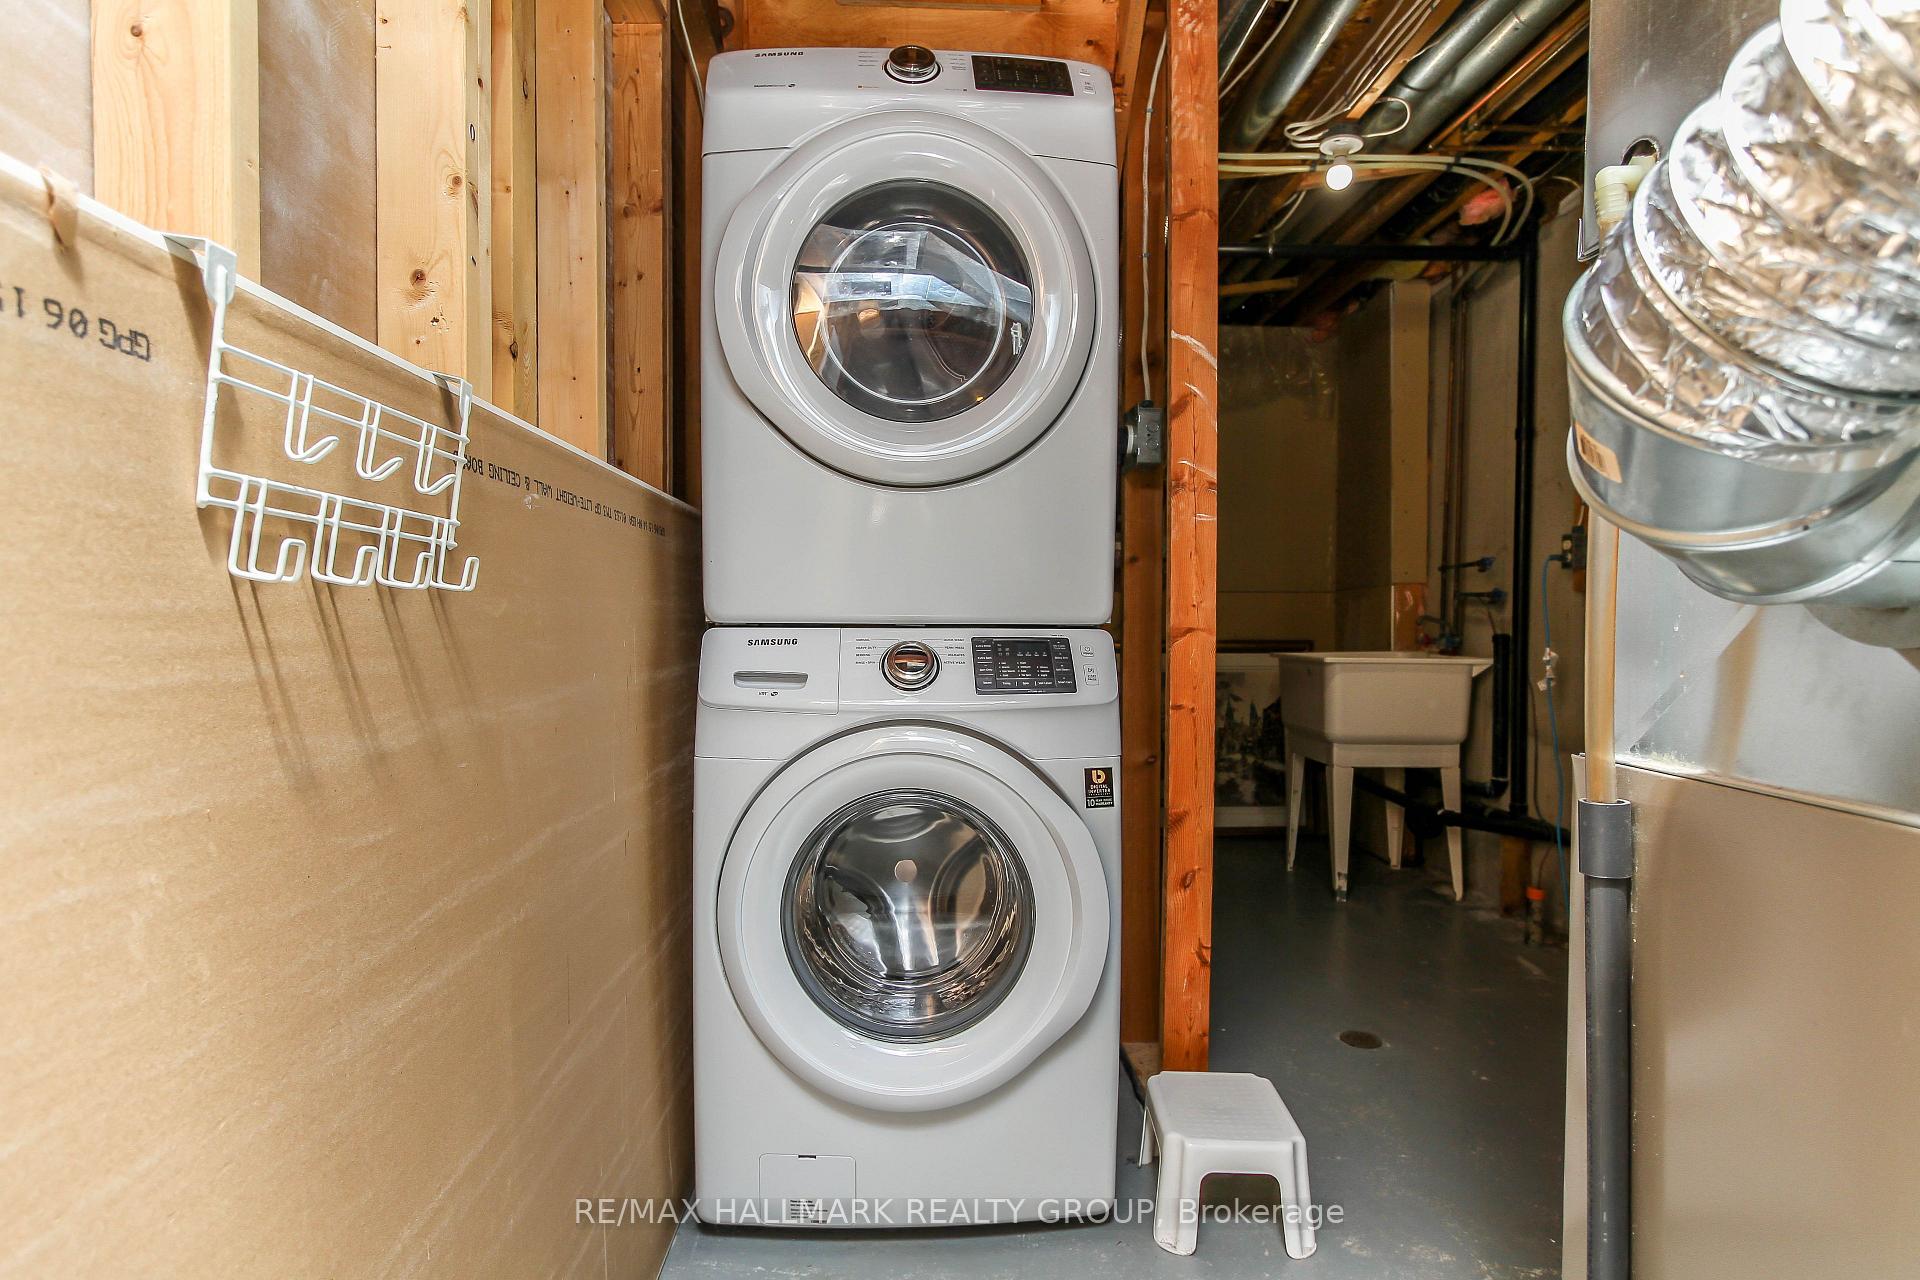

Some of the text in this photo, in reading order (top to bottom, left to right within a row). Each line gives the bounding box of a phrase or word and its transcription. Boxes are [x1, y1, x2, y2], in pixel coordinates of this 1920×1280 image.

[43, 298, 88, 338] 06
[98, 318, 150, 361] GPG
[488, 462, 521, 488] CEILING
[524, 475, 530, 491] &
[533, 479, 553, 499] WALL
[555, 487, 593, 512] LITE-WEIGHT
[747, 638, 798, 647] SAMSUNG
[1087, 798, 1096, 807] 10
